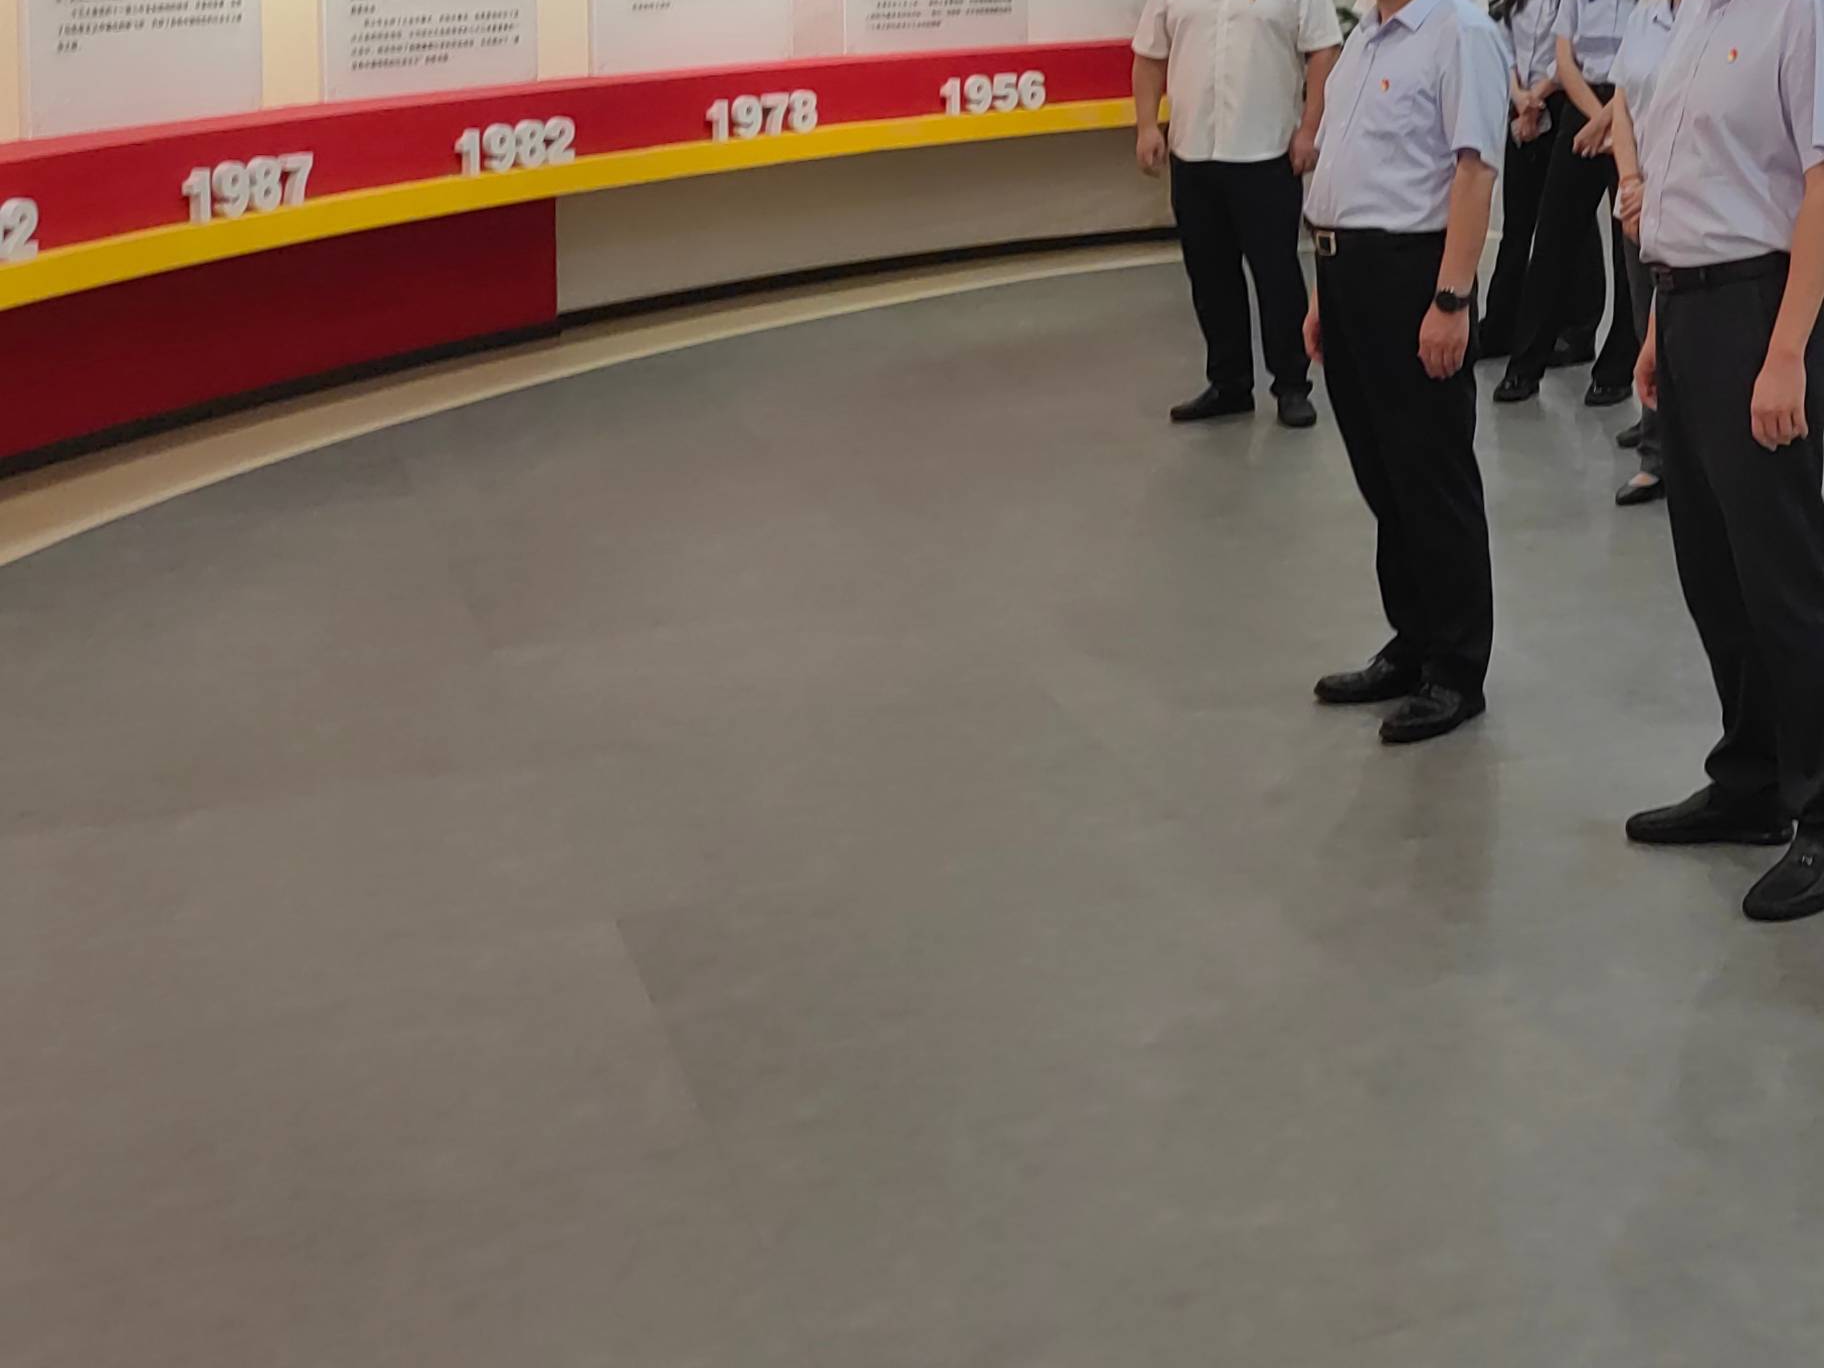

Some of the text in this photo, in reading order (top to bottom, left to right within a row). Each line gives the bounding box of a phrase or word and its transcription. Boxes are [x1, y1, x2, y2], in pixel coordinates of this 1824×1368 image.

[705, 90, 818, 143] 1978
[939, 69, 1046, 117] 1956
[455, 116, 576, 178] 1982
[182, 151, 314, 225] 1987
